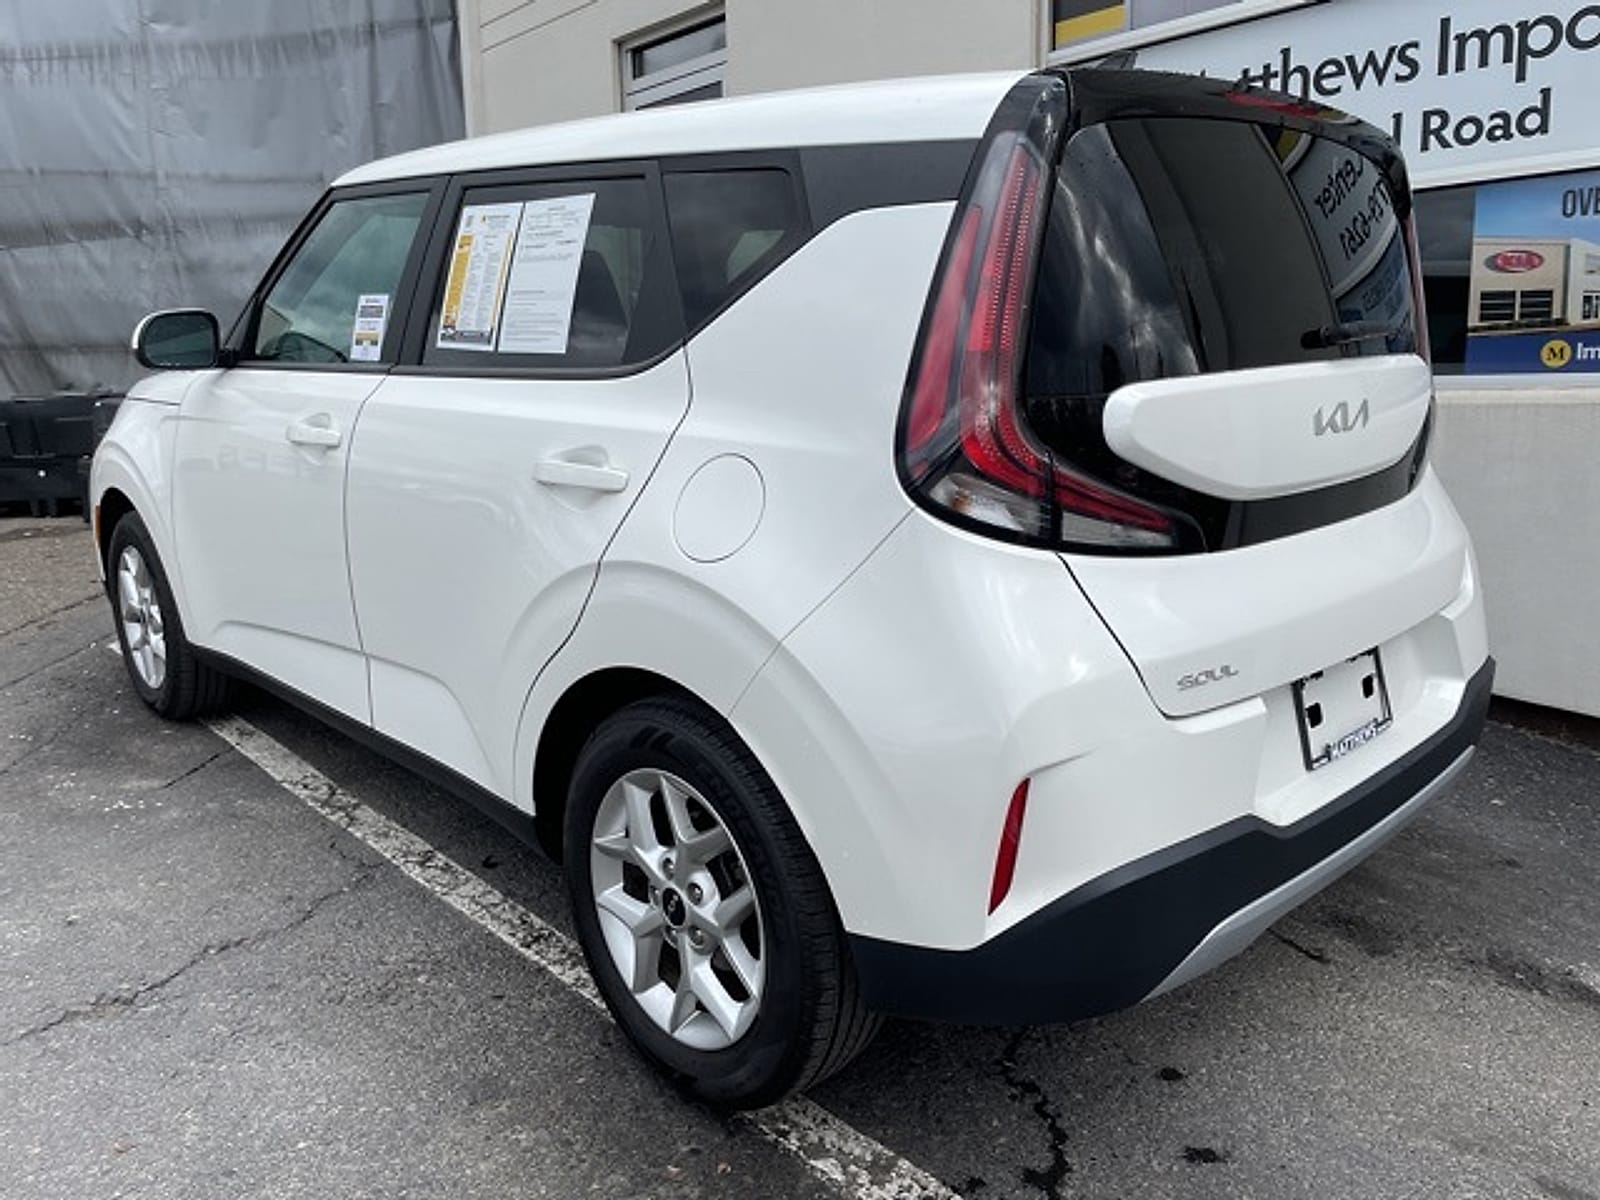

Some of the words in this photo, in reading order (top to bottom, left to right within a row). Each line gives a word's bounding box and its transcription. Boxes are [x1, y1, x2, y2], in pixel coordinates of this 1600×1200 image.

[1200, 40, 1421, 101] tthews
[1437, 5, 1600, 84] Impo
[1420, 87, 1552, 152] Road
[1312, 398, 1369, 436] KIA
[1177, 664, 1239, 691] SOUL
